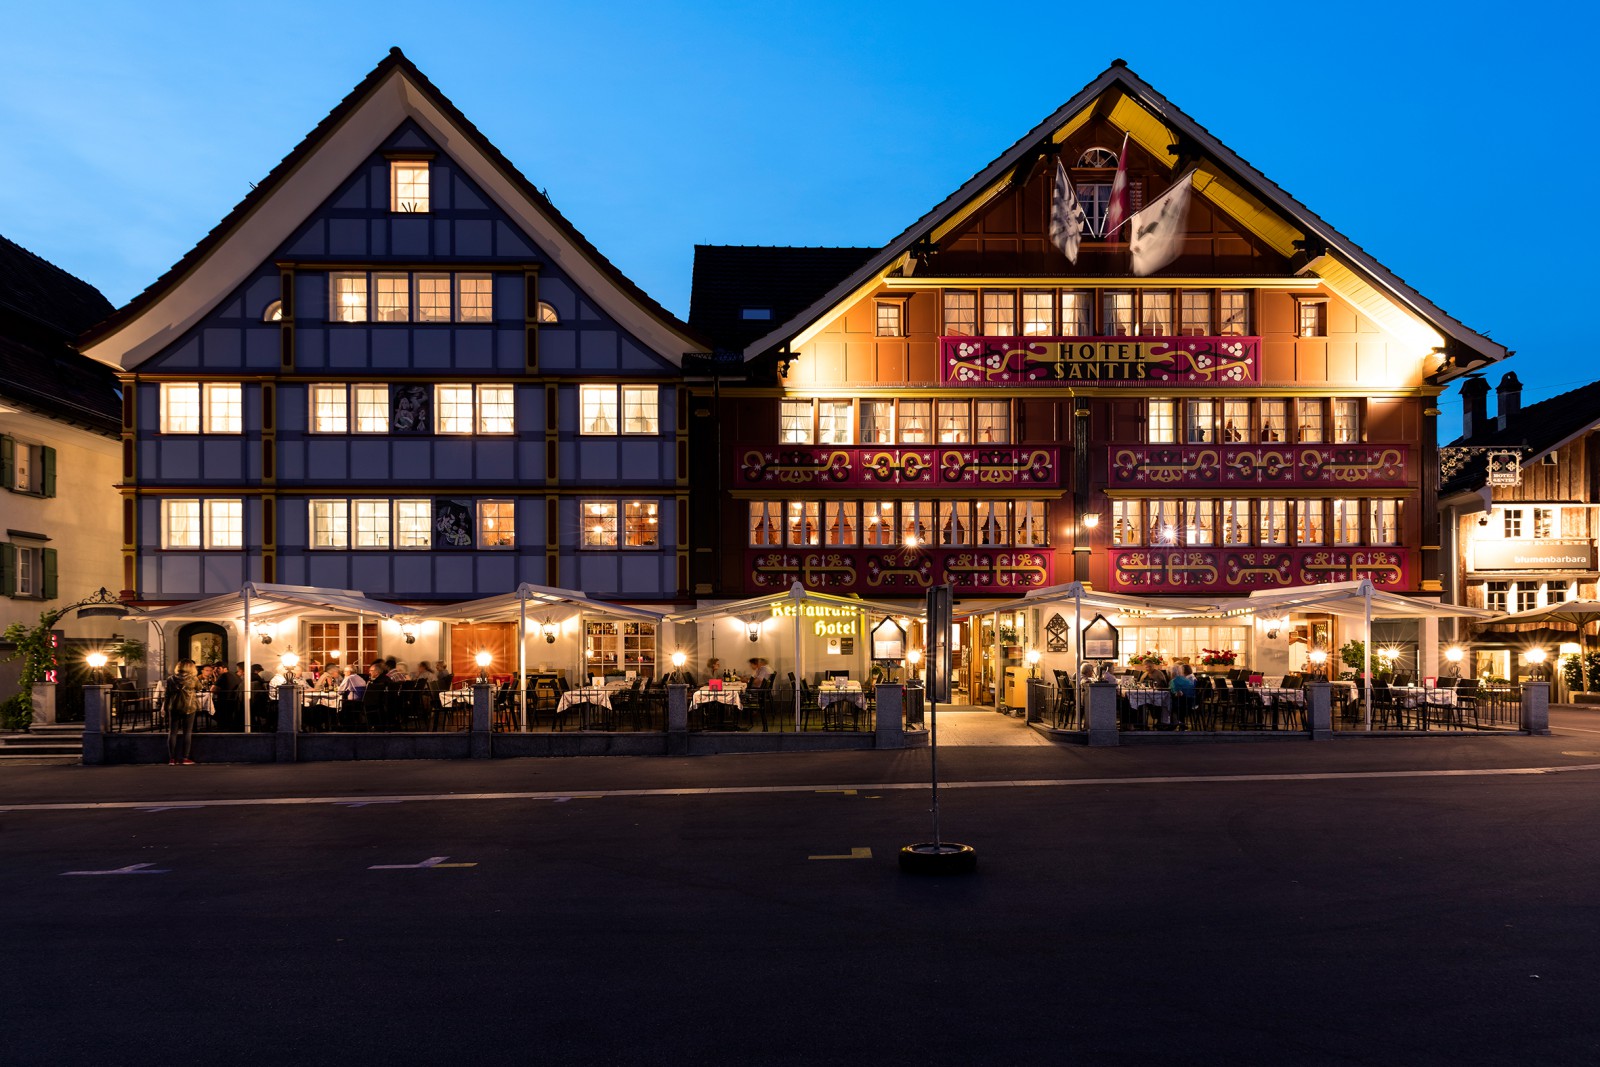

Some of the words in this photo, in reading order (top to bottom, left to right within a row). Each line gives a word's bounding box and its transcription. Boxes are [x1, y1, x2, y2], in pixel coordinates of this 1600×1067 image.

[1060, 344, 1145, 360] HOTEL
[1054, 362, 1146, 379] SÄNTIS
[815, 620, 856, 637] Hotel
